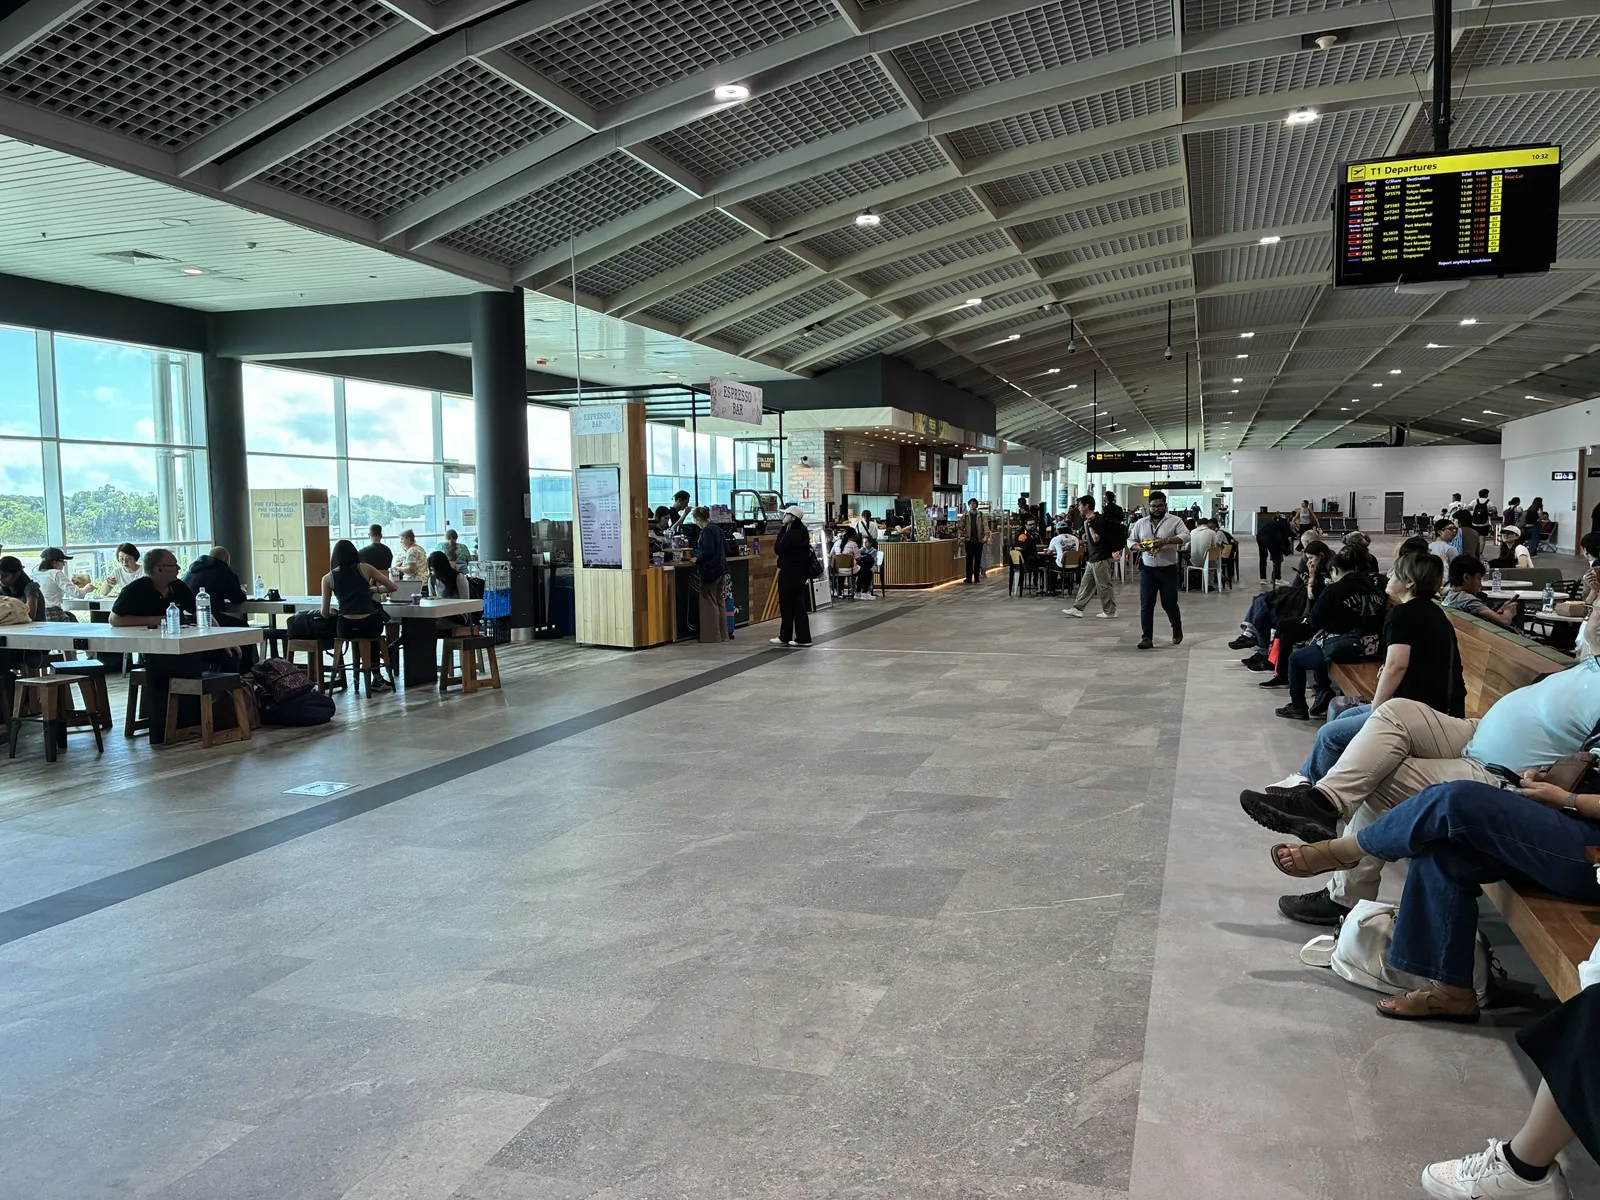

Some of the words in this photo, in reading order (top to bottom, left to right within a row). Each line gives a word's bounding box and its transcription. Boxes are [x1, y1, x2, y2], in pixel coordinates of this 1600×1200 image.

[1371, 167, 1381, 175] T1
[1385, 163, 1437, 175] Departures
[723, 386, 752, 404] ESPRESSO
[732, 403, 743, 415] BAR
